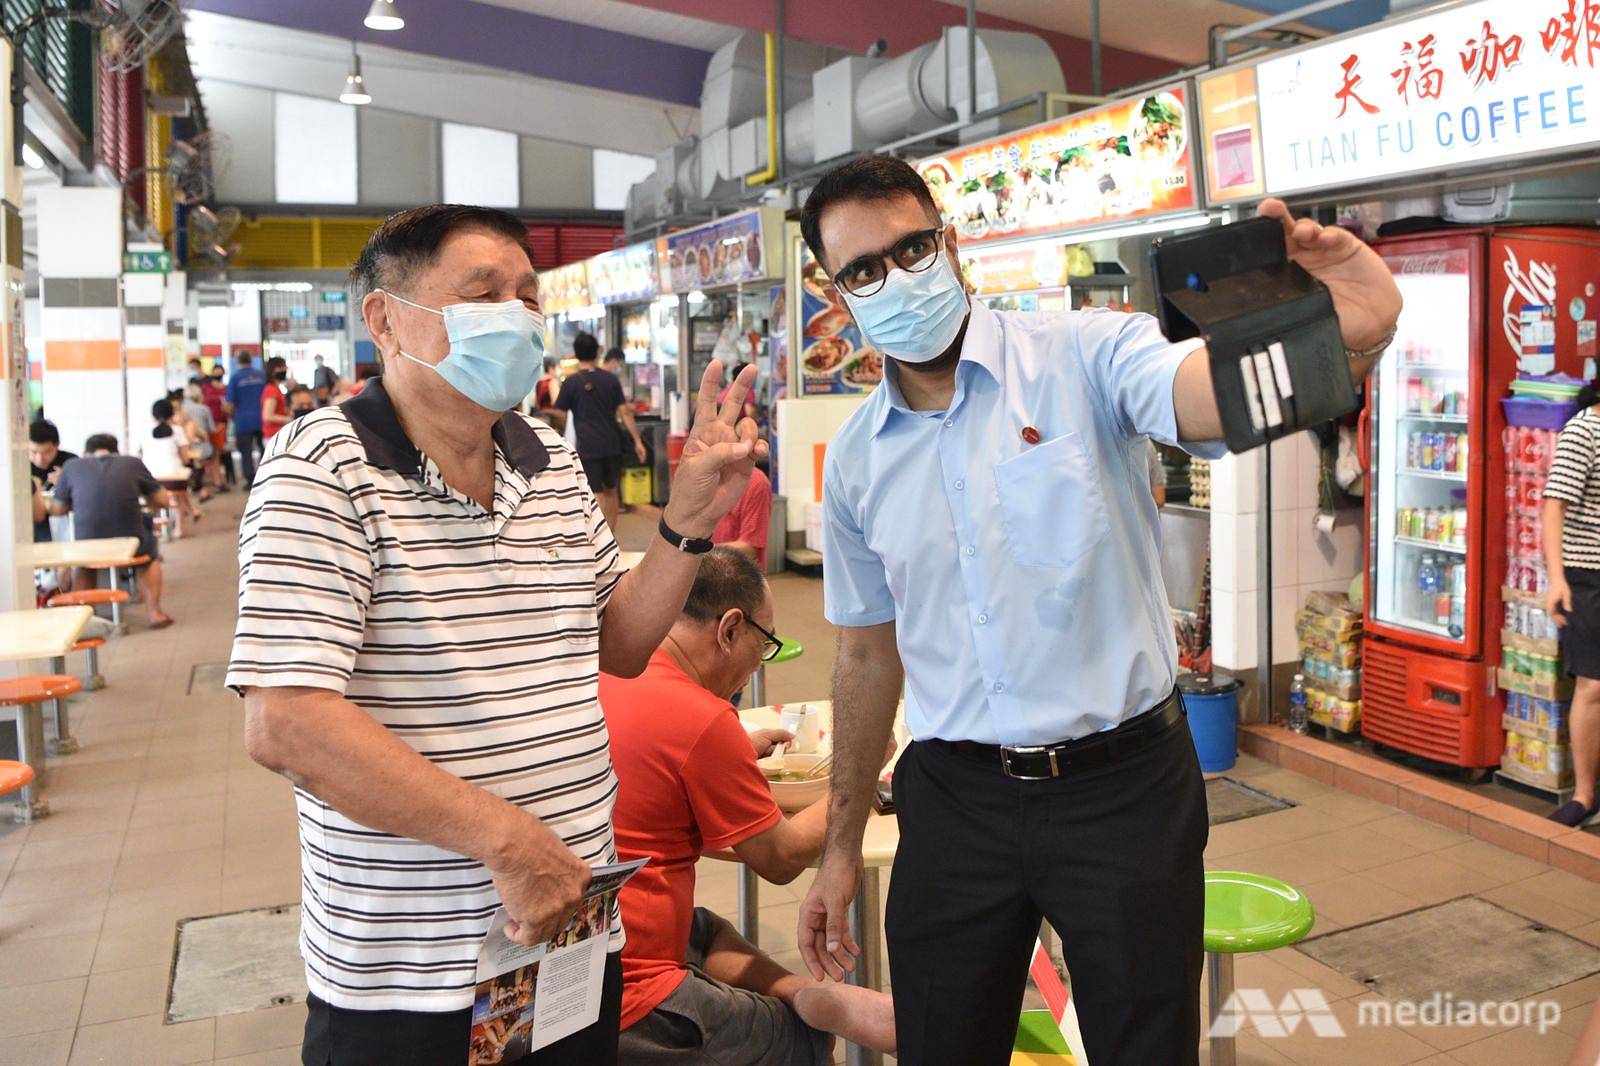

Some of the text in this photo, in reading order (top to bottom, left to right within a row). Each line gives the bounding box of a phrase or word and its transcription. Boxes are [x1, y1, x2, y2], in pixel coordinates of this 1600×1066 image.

[1288, 84, 1587, 172] TIAN FU COFFEE
